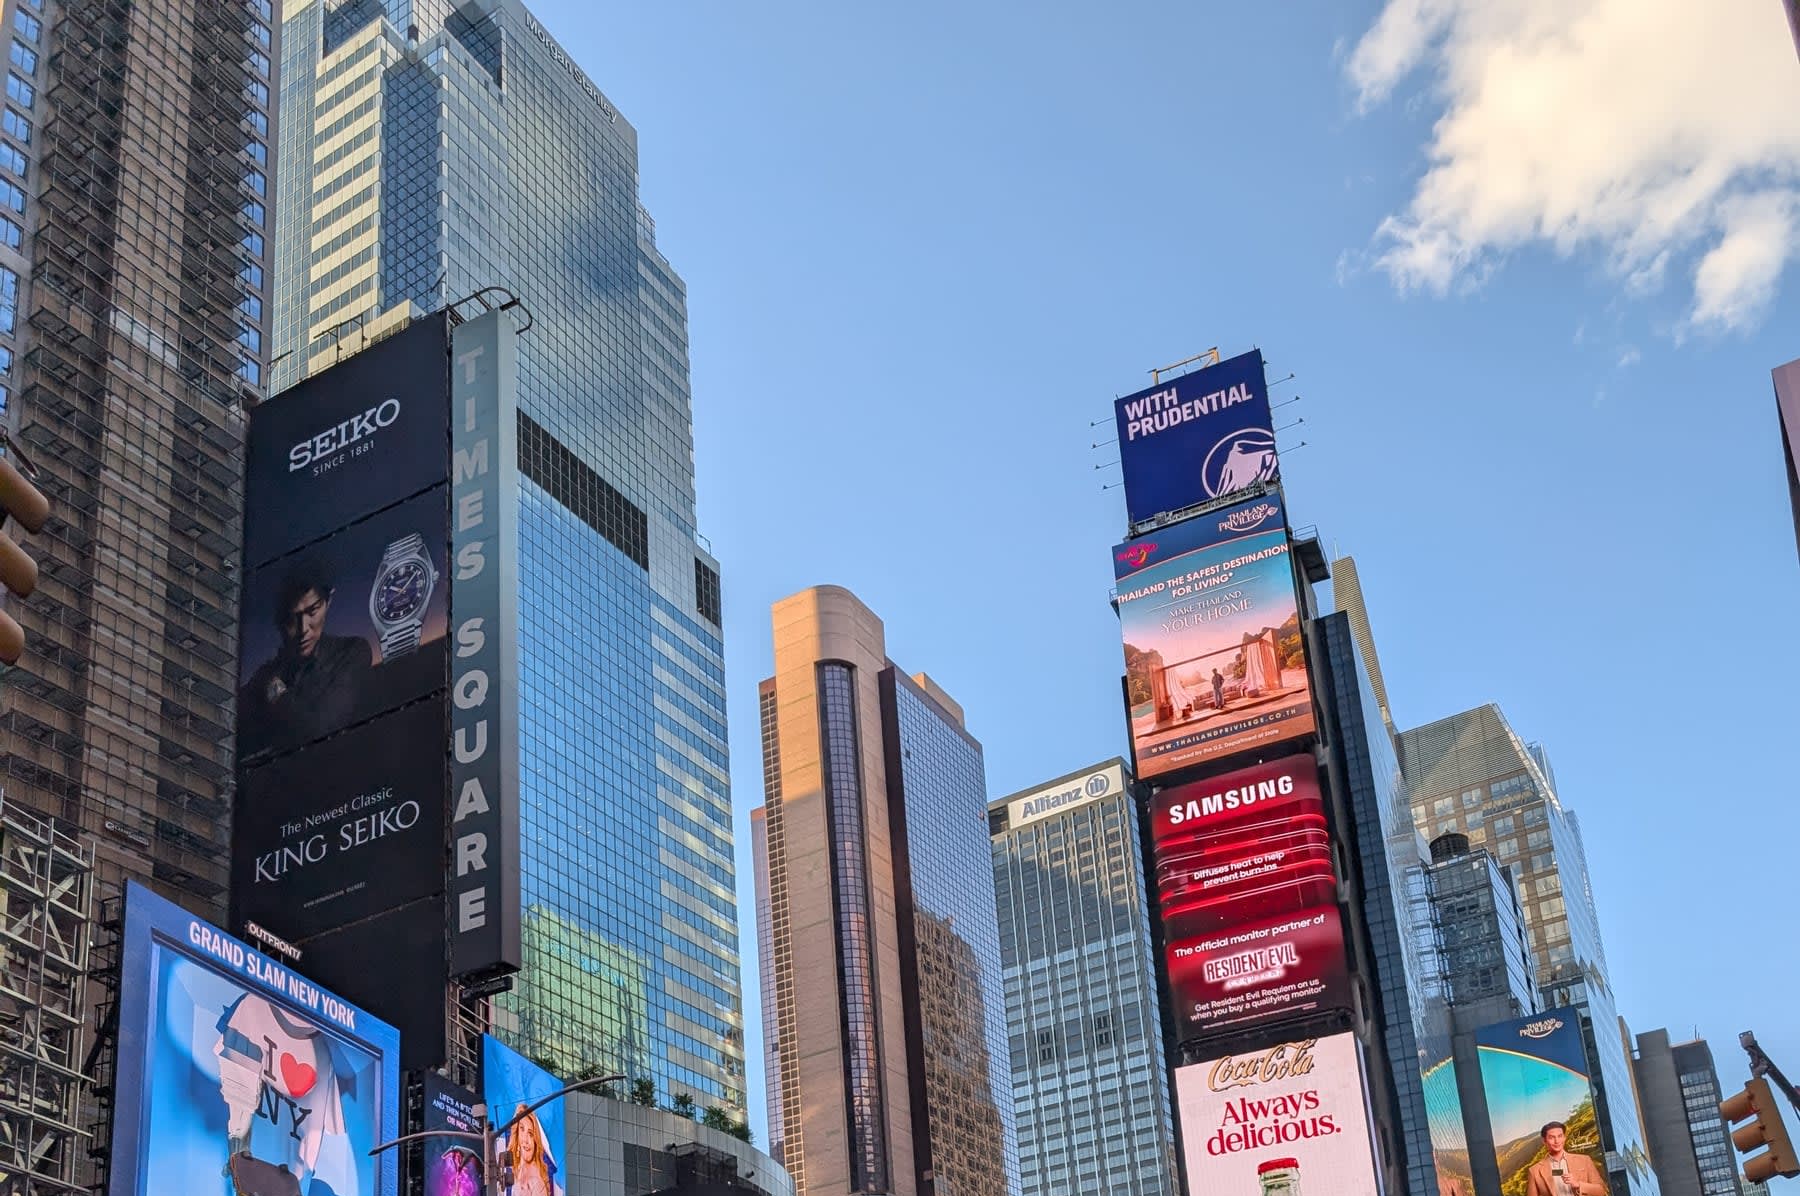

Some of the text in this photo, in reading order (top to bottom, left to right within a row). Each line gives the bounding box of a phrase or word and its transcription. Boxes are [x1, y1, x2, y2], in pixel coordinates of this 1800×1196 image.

[1124, 387, 1178, 421] WITH
[1127, 382, 1253, 441] PRUDENTIAL
[288, 399, 401, 472] SEIKO
[313, 440, 375, 477] SINCE 1881
[1219, 511, 1264, 532] PRIVILEGE
[1227, 503, 1268, 521] THAILAND
[1167, 576, 1185, 589] THE
[1187, 565, 1222, 582] SAFEST
[1223, 543, 1288, 574] DESTINATION
[1169, 590, 1242, 618] MAKE THAILAND
[1172, 586, 1192, 598] FOR
[453, 344, 489, 933] TIMES SQUARE
[1161, 613, 1204, 633] YOUR
[280, 786, 393, 838] The Newest Classic
[1022, 787, 1083, 818] Allianz
[1168, 775, 1294, 825] SAMSUNG
[254, 800, 420, 883] KING SEIKO
[1193, 851, 1285, 880] Diffuses heat to help
[1203, 874, 1239, 888] prevent
[1175, 913, 1325, 958] The official monitor partner of
[189, 921, 356, 1030] GRAND SLAM NEW YORK
[1206, 950, 1265, 981] RESIDENT
[1268, 944, 1297, 967] EVIL
[1190, 1011, 1212, 1021] when
[1213, 1008, 1228, 1018] you
[1229, 1004, 1244, 1013] buy
[1251, 992, 1290, 1008] qualifying
[1195, 1002, 1209, 1012] Get
[1211, 996, 1244, 1008] Resident
[1246, 991, 1260, 1001] Evil
[1261, 984, 1296, 998] Requiem
[1298, 981, 1308, 989] on
[264, 1033, 279, 1082] I
[1207, 1038, 1319, 1093] Coca-Cola
[256, 1083, 313, 1141] NY
[1221, 1089, 1320, 1127] Always
[1206, 1113, 1342, 1156] delicious.
